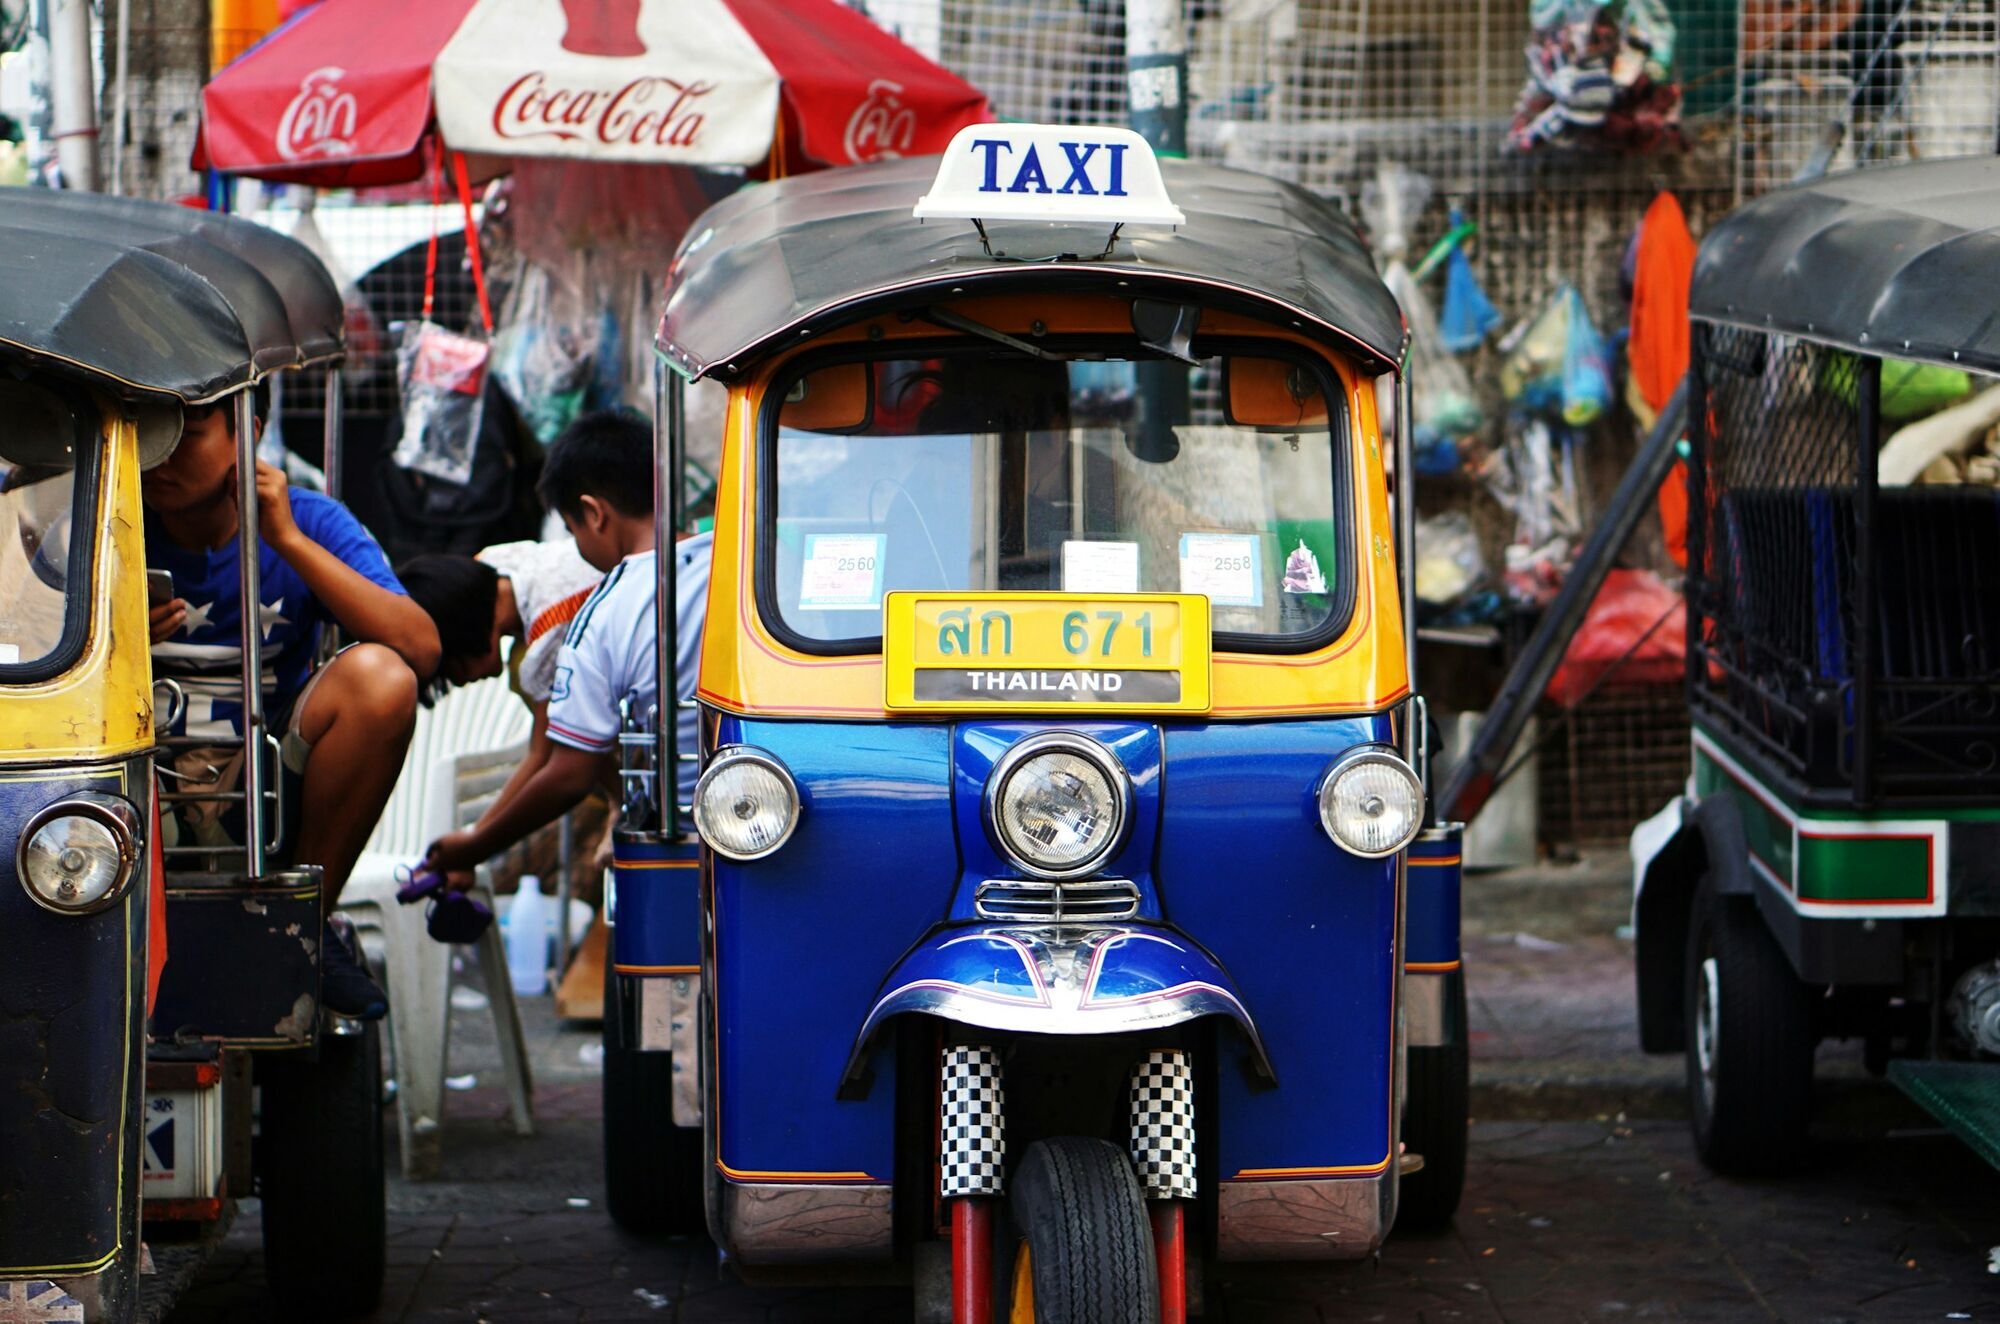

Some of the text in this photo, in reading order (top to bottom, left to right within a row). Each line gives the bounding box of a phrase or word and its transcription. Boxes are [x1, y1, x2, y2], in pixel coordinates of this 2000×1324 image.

[493, 71, 718, 146] Coca-Cola
[970, 139, 1129, 196] TAXI
[838, 557, 875, 571] 2560
[1215, 556, 1251, 571] 2558
[937, 607, 1152, 657] สก 671
[967, 671, 1122, 692] THAILAND
